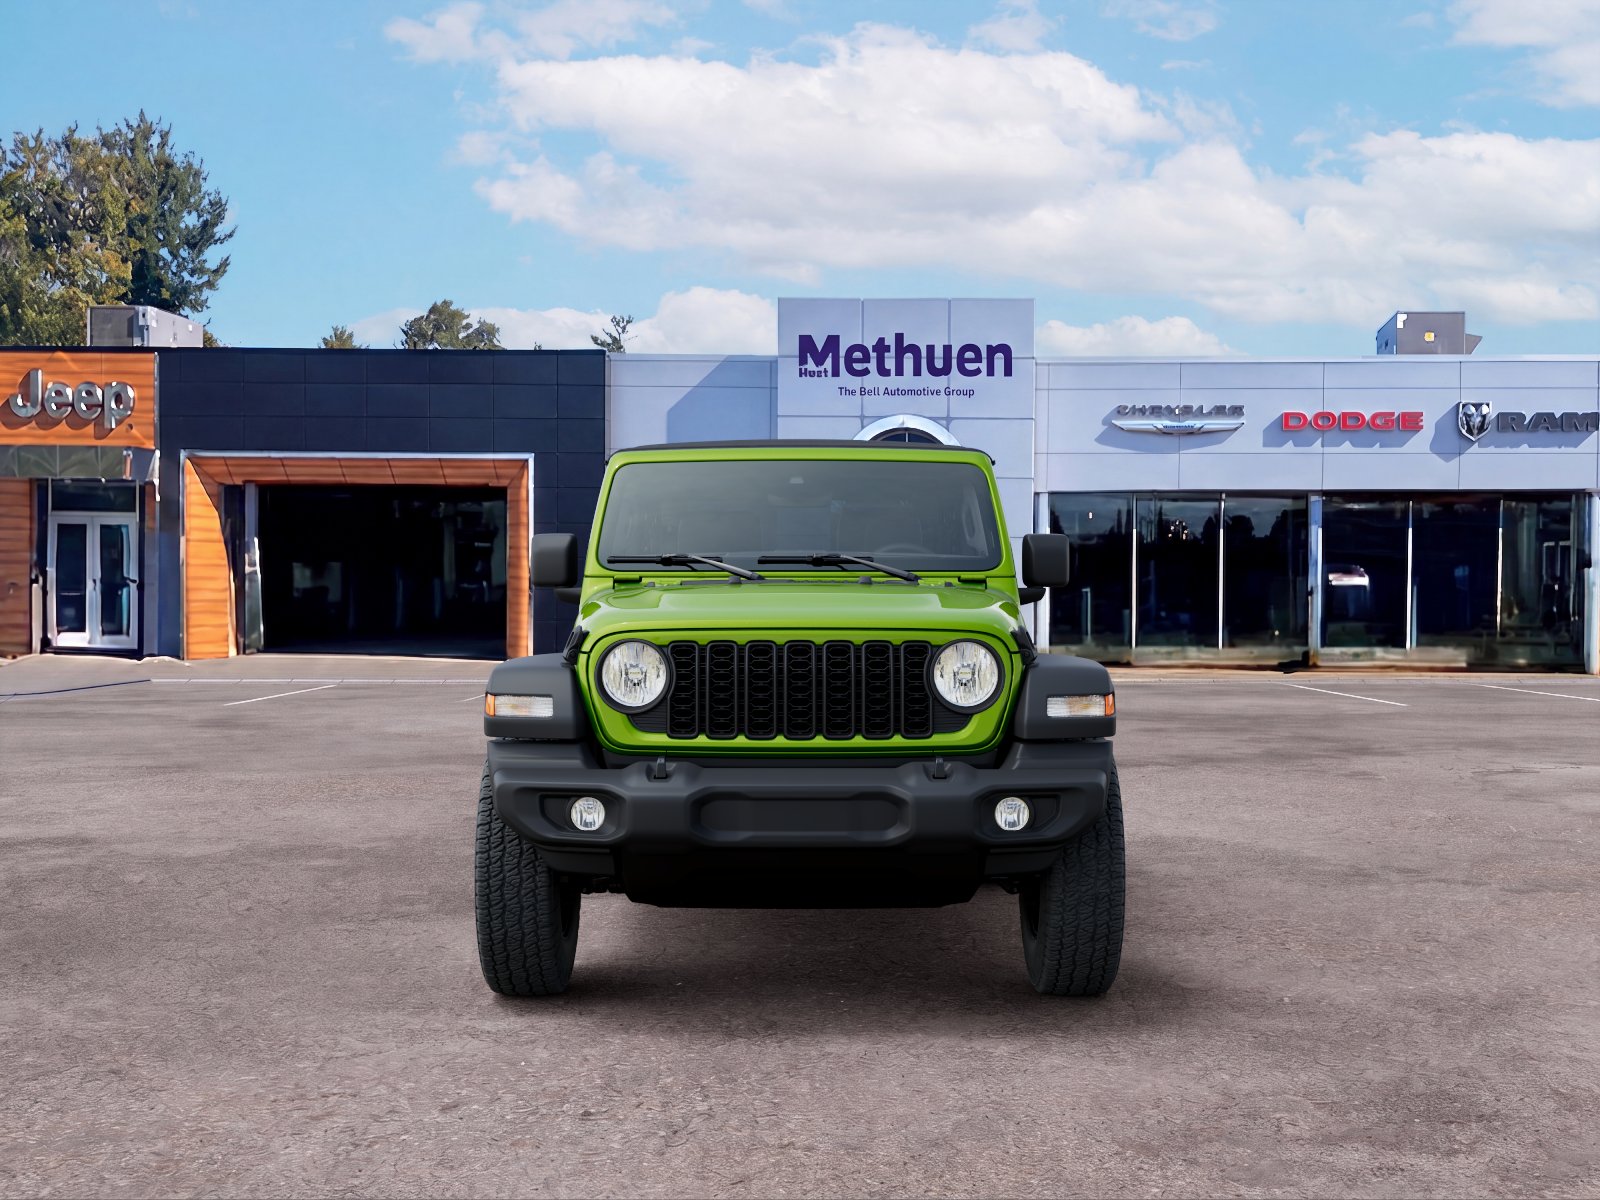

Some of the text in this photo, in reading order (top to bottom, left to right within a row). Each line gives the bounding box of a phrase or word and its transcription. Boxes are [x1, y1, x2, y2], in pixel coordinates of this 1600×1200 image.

[799, 333, 1013, 378] Methuen
[9, 368, 135, 429] Jeep
[838, 387, 975, 398] The Bell Automotive Group
[1282, 411, 1424, 430] DODGE
[1497, 411, 1600, 432] RAM
